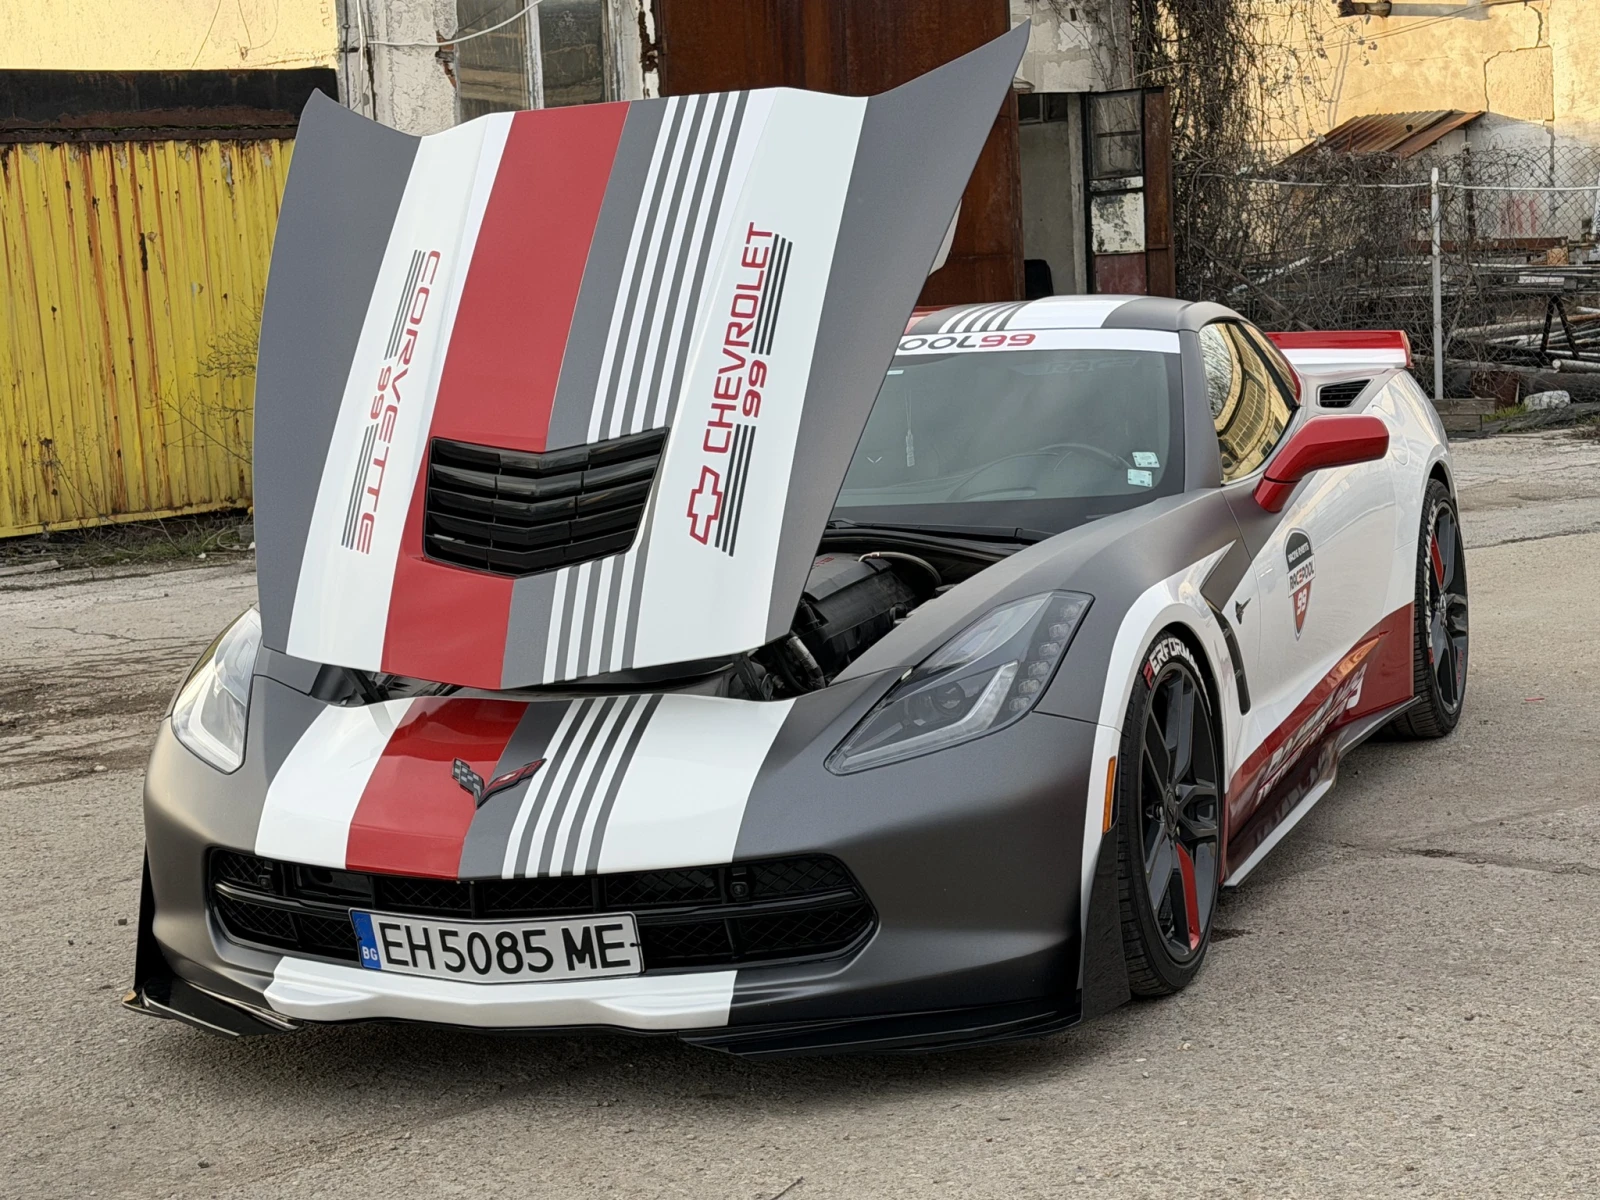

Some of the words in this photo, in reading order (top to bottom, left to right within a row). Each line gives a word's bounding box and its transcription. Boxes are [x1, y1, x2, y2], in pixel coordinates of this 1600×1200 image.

[702, 221, 773, 454] CHEVROLET
[357, 250, 441, 555] CORVETTE
[370, 365, 392, 420] 99
[742, 360, 768, 418] 99
[1296, 588, 1308, 616] 99
[362, 946, 379, 961] BG
